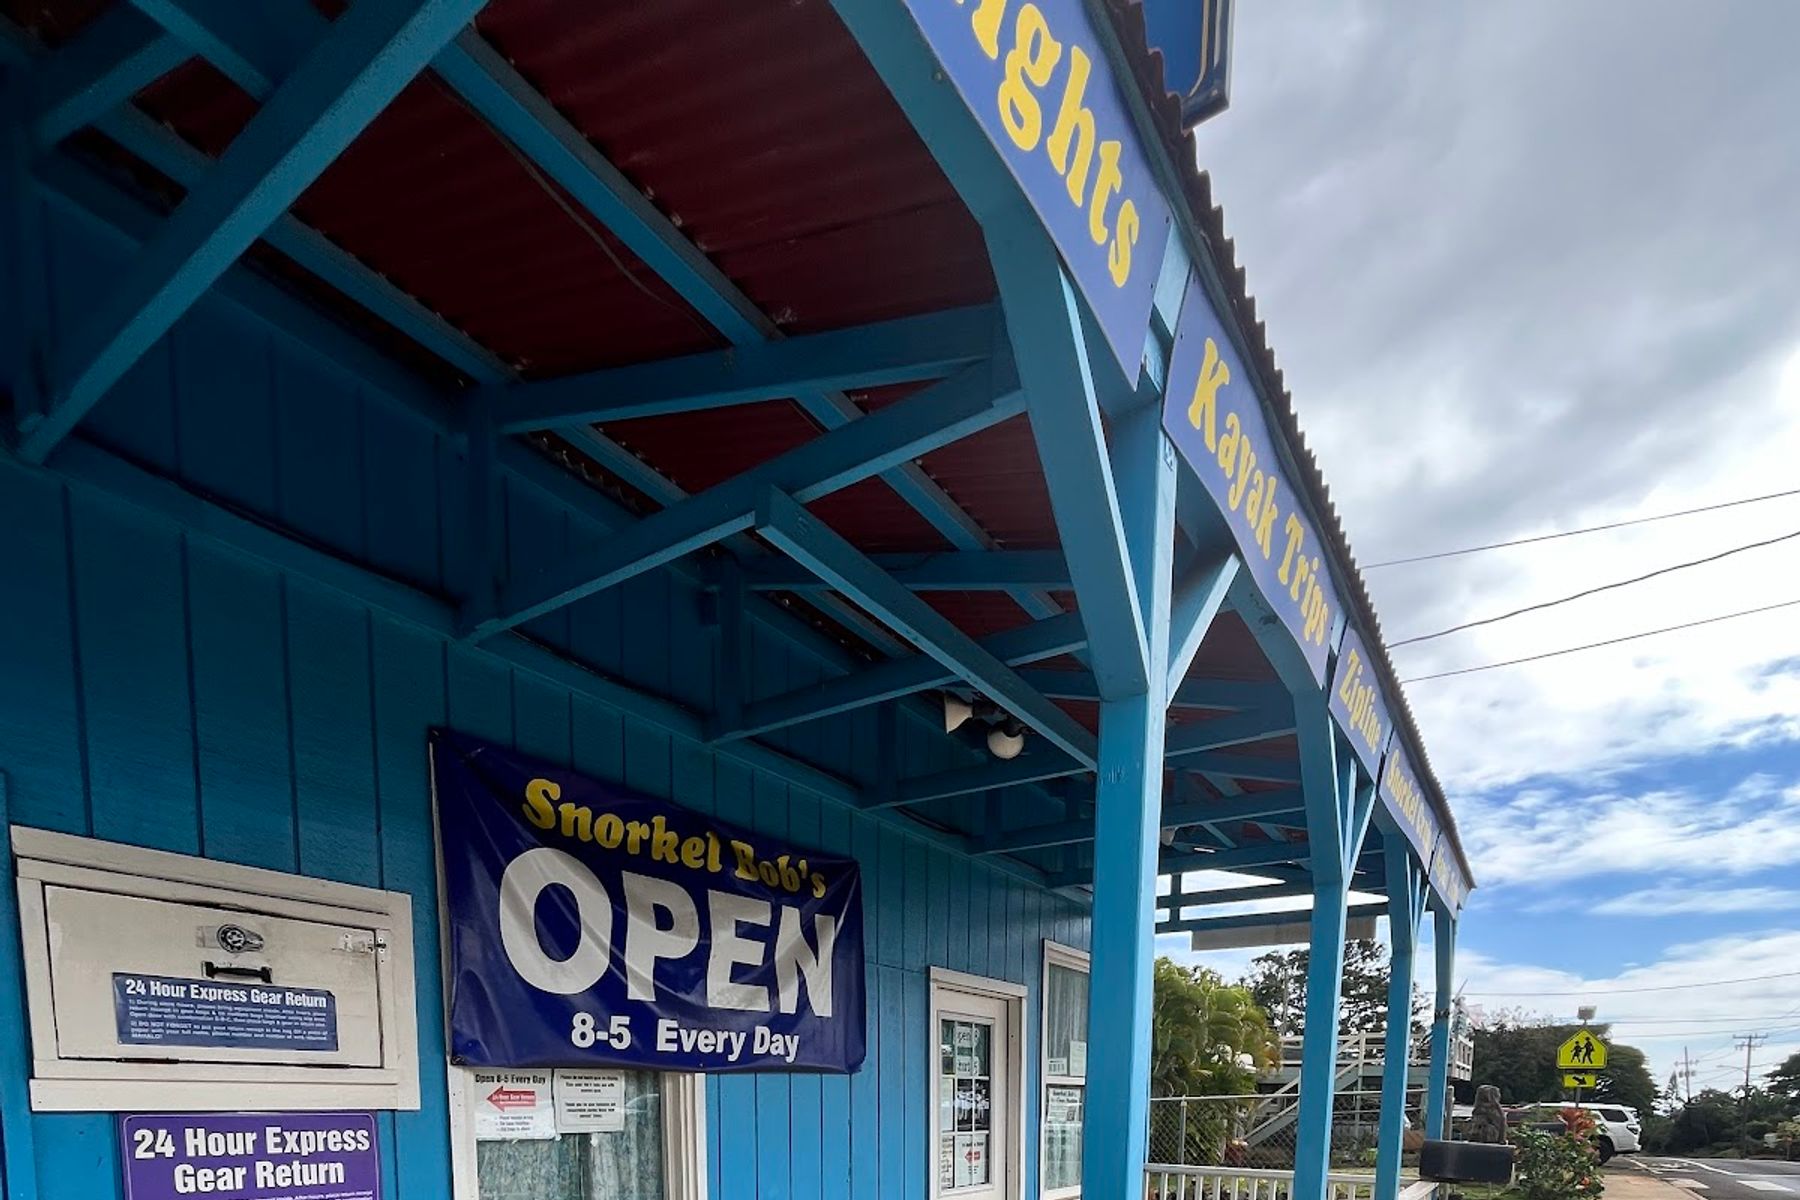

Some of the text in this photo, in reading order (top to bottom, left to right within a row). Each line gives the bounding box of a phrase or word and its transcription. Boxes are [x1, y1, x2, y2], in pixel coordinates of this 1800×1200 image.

[1188, 337, 1329, 646] Kayak Trips
[1340, 648, 1382, 755] Zipline
[521, 778, 826, 898] Snorkel Bob's
[499, 847, 835, 1017] OPEN
[125, 979, 146, 996] 24
[150, 982, 187, 999] Hour
[190, 984, 248, 1004] Express
[250, 988, 283, 1006] Gear
[285, 990, 327, 1009] Return
[570, 1011, 800, 1062] 8-5 Every Day
[475, 1073, 546, 1085] Open 8-5 Every Day
[133, 1126, 371, 1159] 24 Hour Express
[173, 1159, 345, 1194] Gear Return
